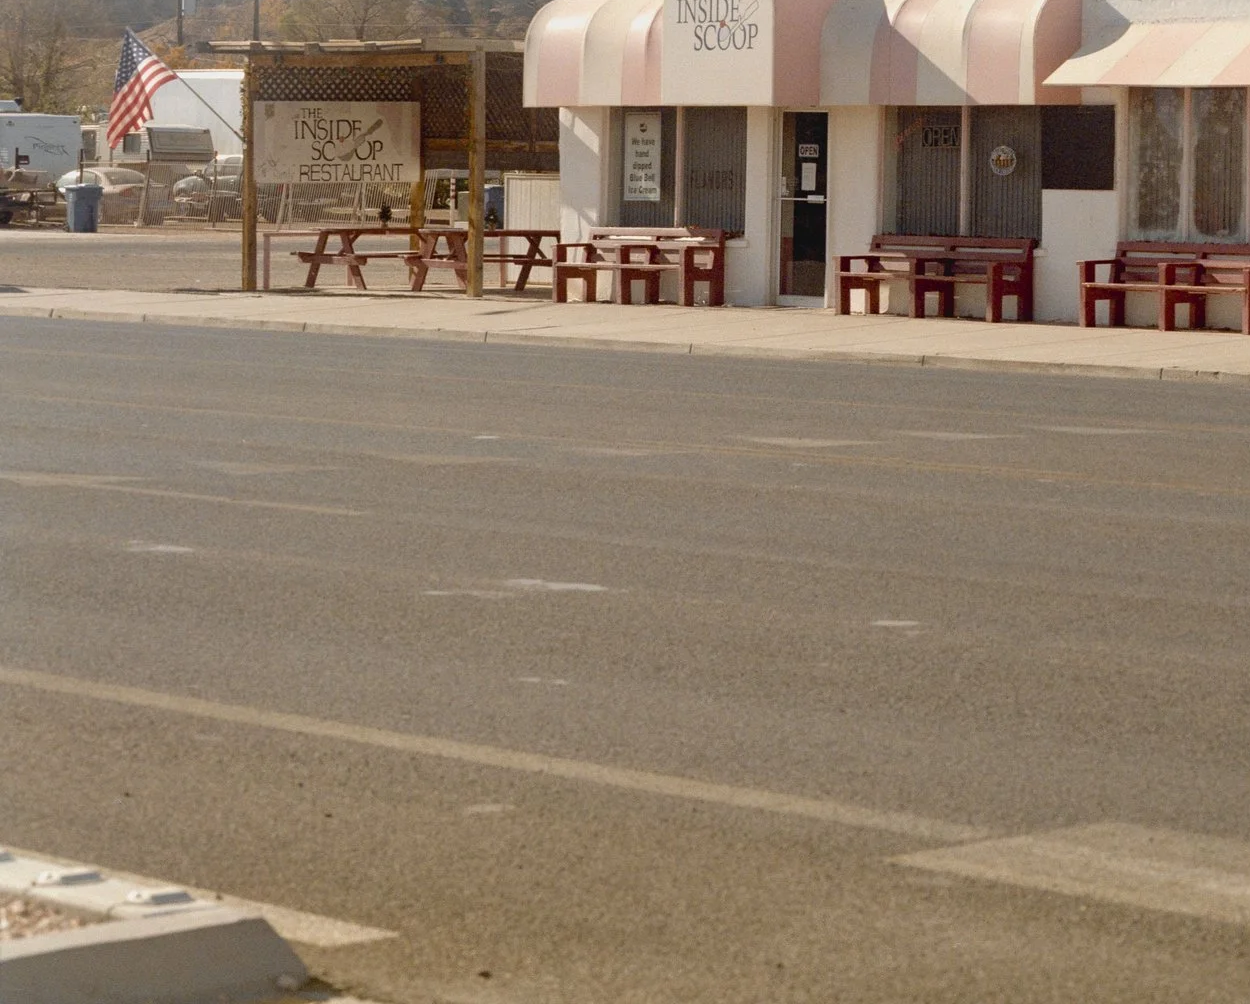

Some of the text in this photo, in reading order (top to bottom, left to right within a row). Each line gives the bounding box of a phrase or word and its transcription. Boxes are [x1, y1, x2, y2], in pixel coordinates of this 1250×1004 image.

[693, 23, 759, 51] SCOOP
[300, 107, 323, 119] THE
[294, 118, 362, 140] INSIDE
[631, 138, 655, 146] We have
[923, 127, 960, 147] OPEN
[311, 140, 383, 161] SCOP
[799, 145, 818, 156] OPEN
[299, 163, 403, 182] RESTAURANT
[632, 161, 652, 172] dipped
[638, 185, 657, 194] Cream
